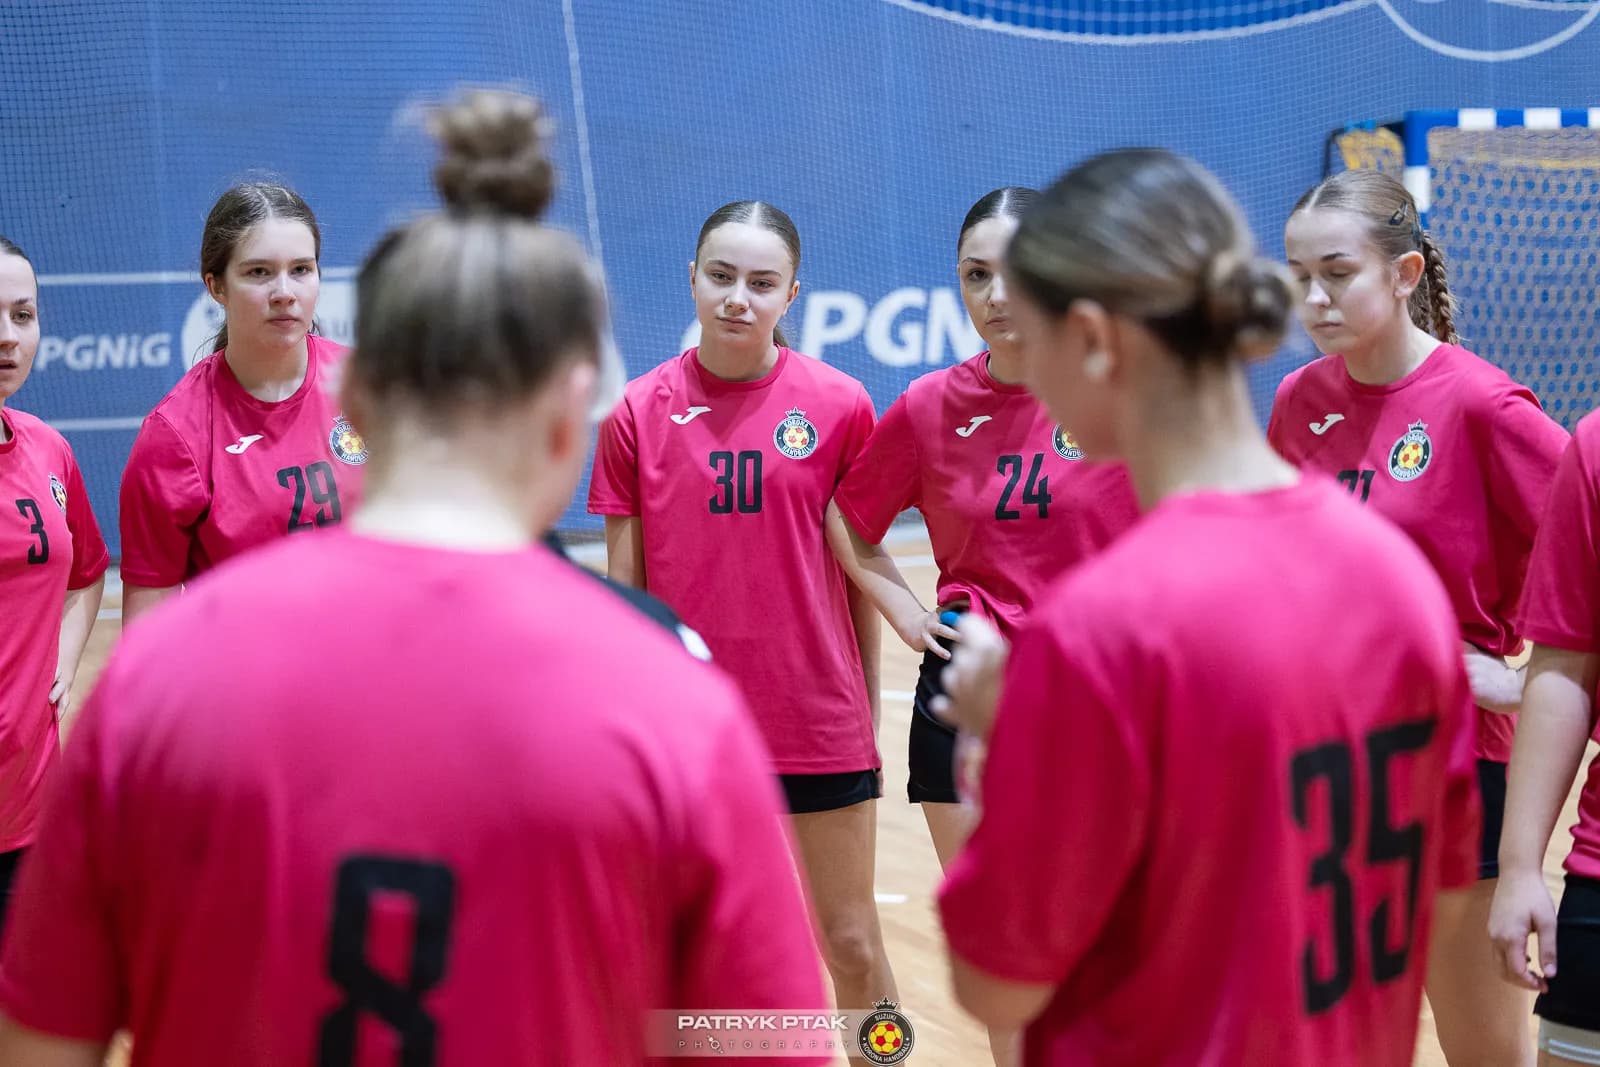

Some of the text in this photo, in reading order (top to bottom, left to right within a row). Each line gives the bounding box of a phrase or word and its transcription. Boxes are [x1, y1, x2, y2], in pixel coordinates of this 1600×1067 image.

[802, 286, 988, 368] PGN
[277, 461, 342, 533] 29
[709, 450, 763, 514] 30
[995, 453, 1052, 520] 24
[15, 498, 50, 565] 3
[1291, 717, 1438, 1016] 35
[321, 855, 456, 1067] 8
